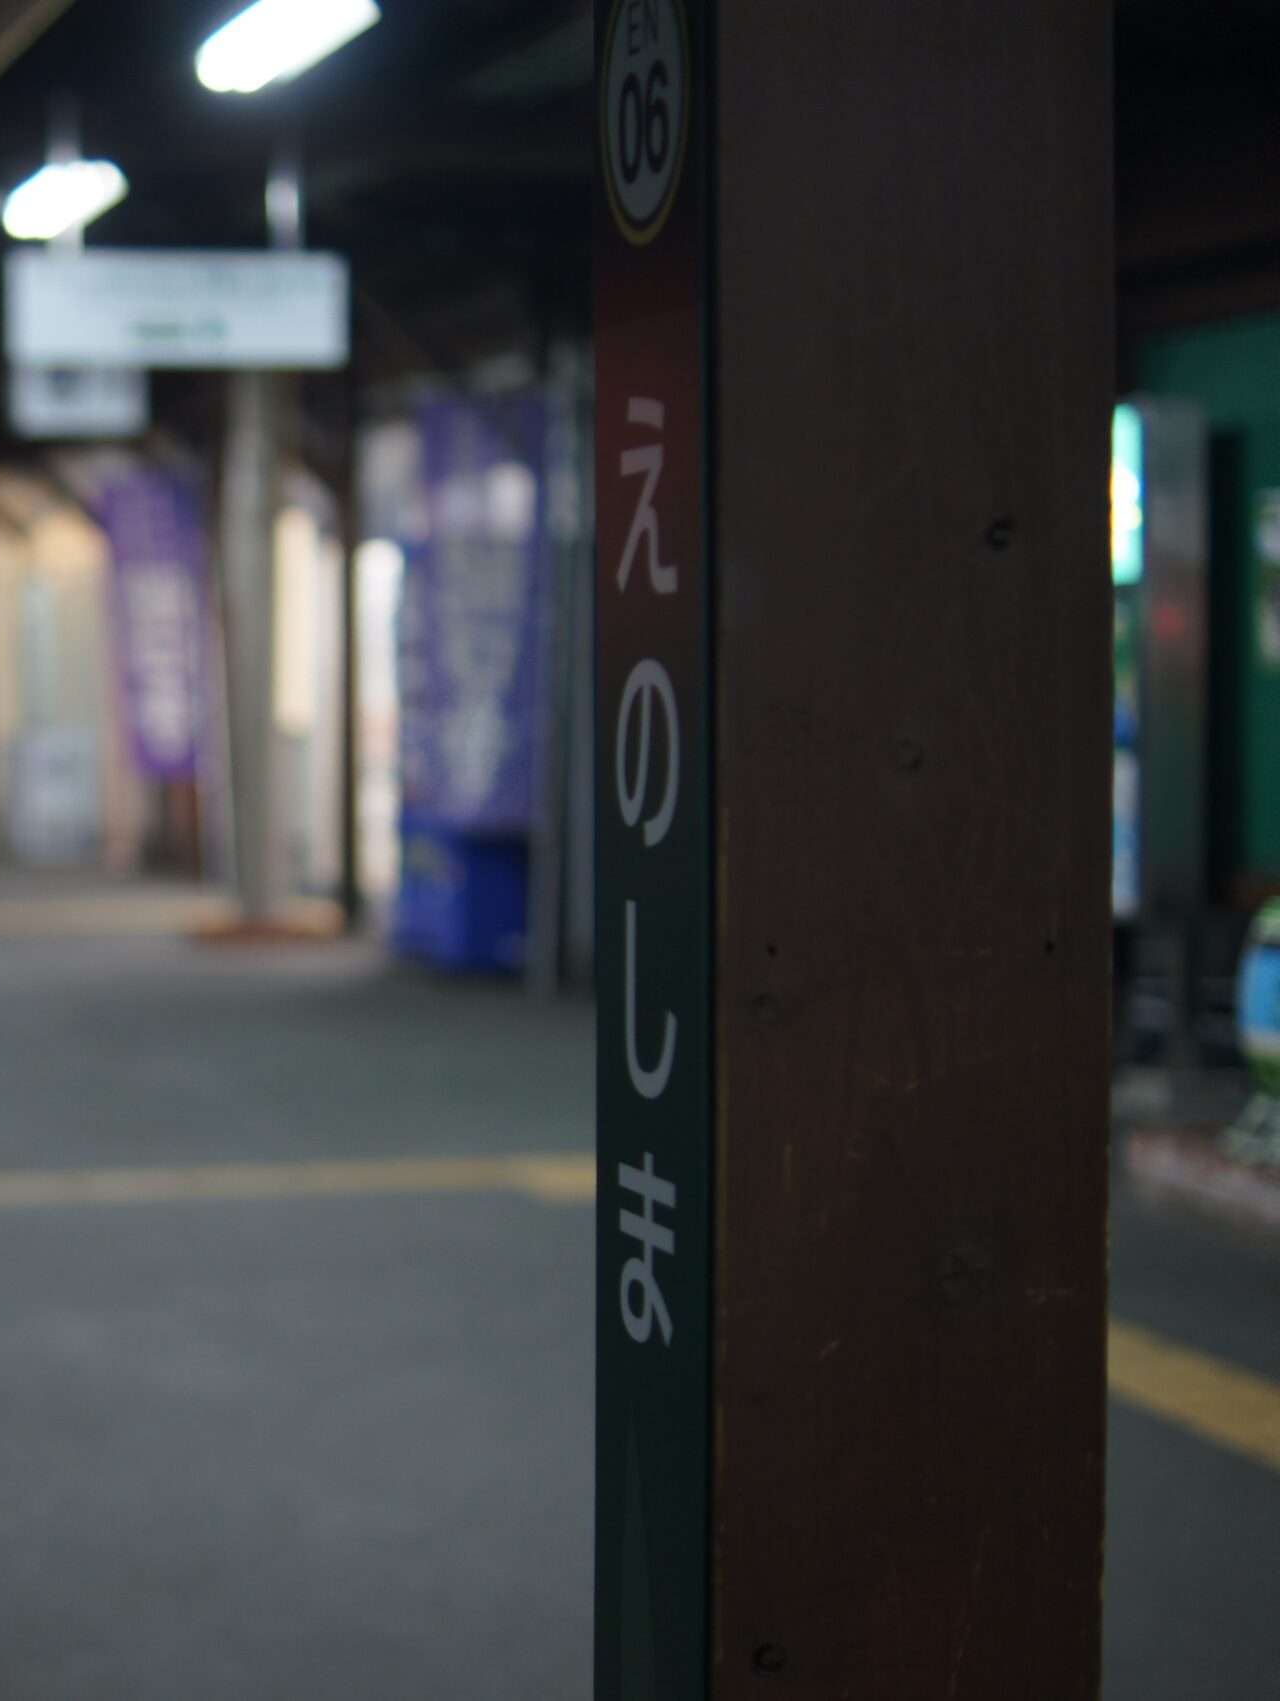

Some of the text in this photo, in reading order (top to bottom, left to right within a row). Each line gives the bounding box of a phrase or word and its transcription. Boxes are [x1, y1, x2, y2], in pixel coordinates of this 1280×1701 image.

[627, 0, 660, 56] EN
[619, 57, 669, 185] 06
[616, 396, 680, 1347] えのしま
